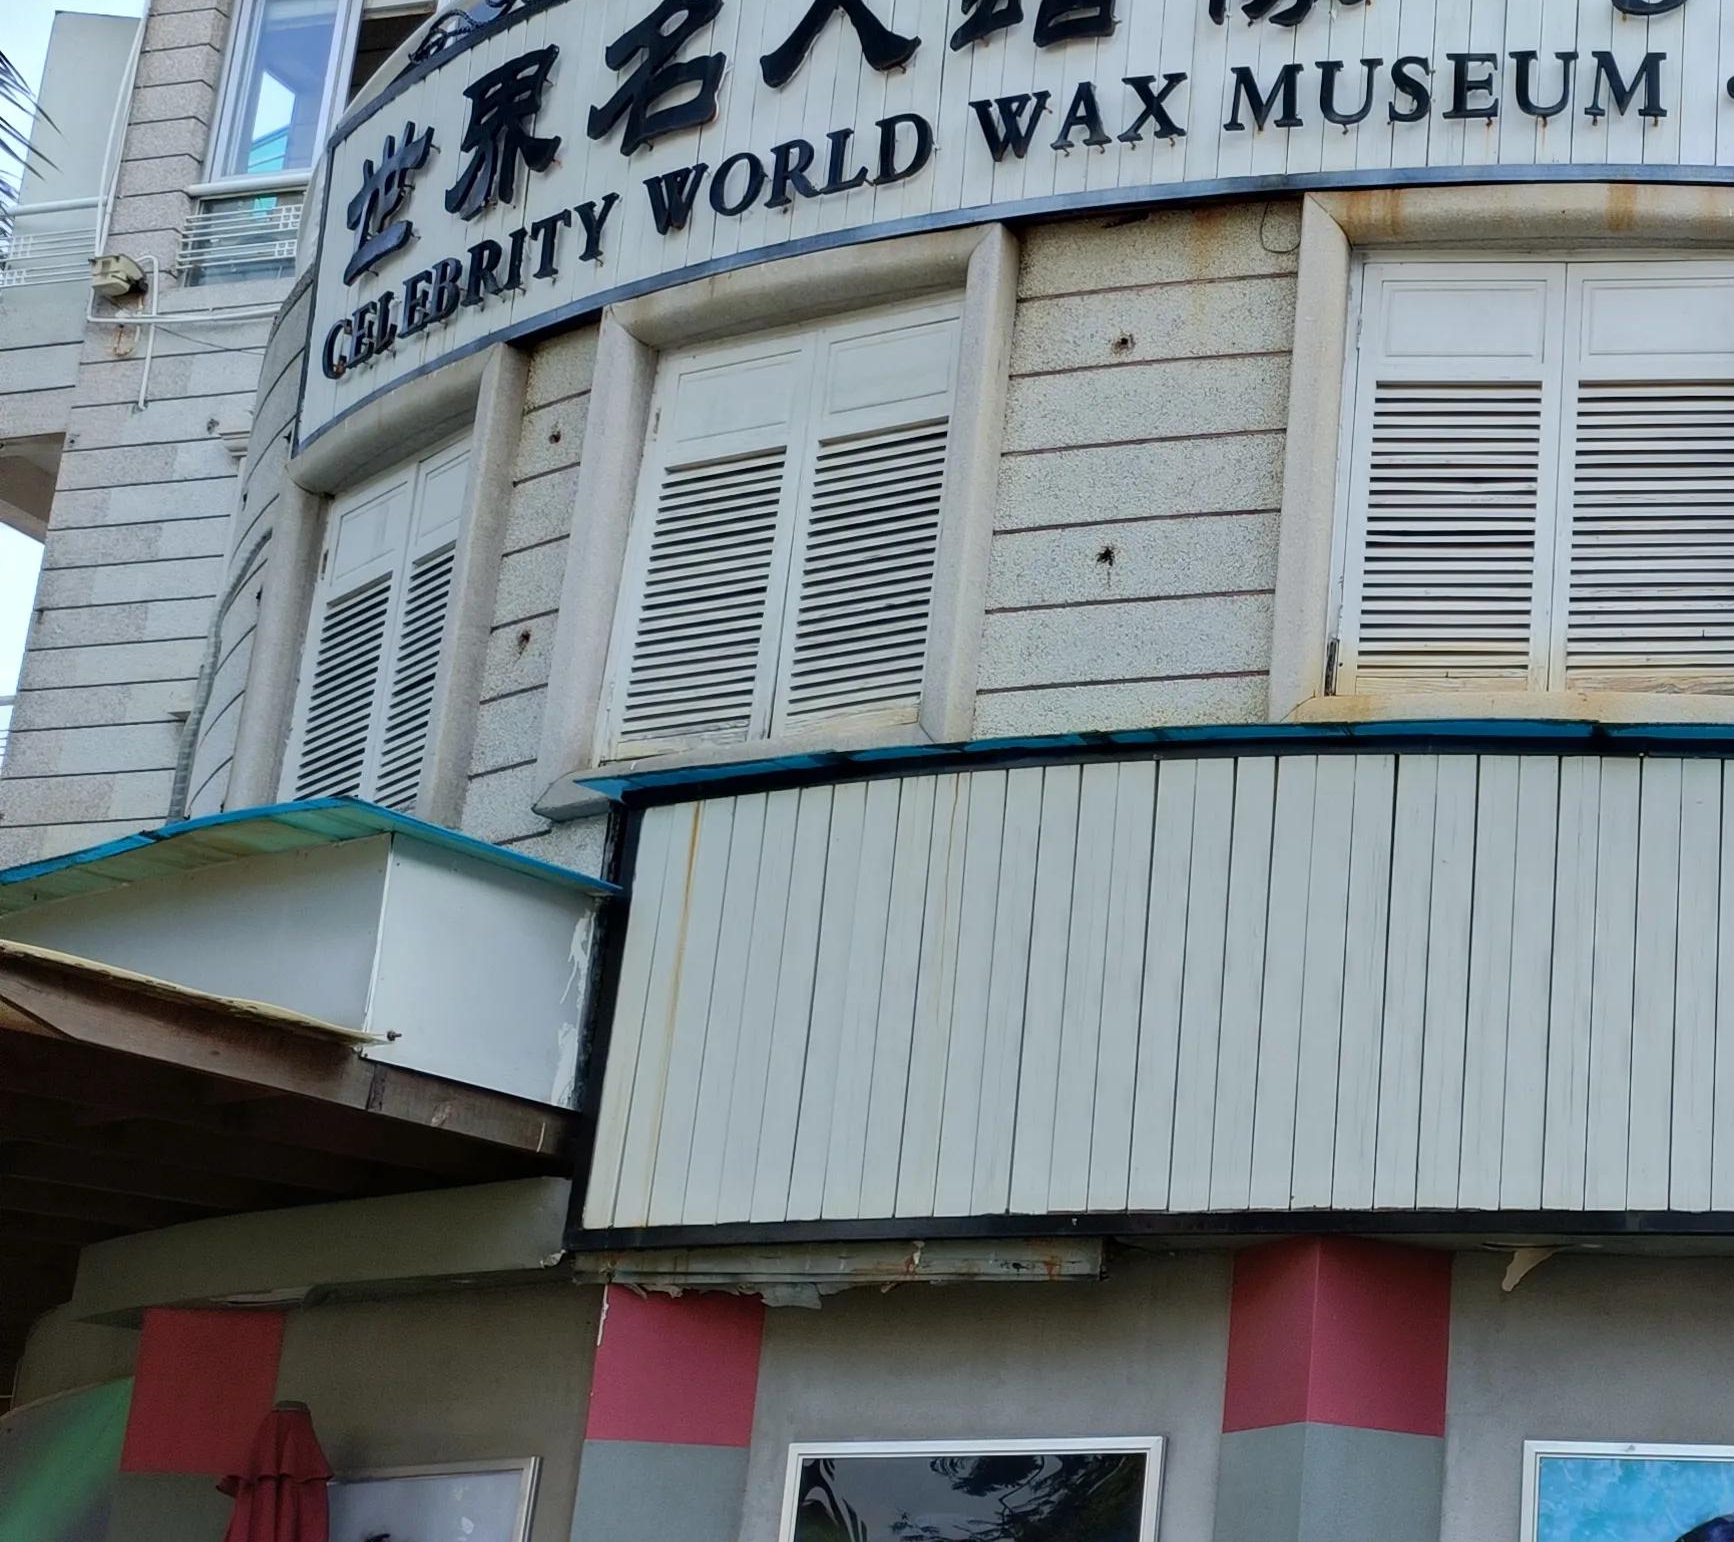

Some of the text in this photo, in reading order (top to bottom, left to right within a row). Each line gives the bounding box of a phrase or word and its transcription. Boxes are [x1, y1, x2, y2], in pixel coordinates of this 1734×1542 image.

[323, 193, 620, 380] CELEBRITY
[643, 113, 934, 236] WORLD
[968, 72, 1189, 163] WAX
[1223, 50, 1668, 132] MUSEUM
